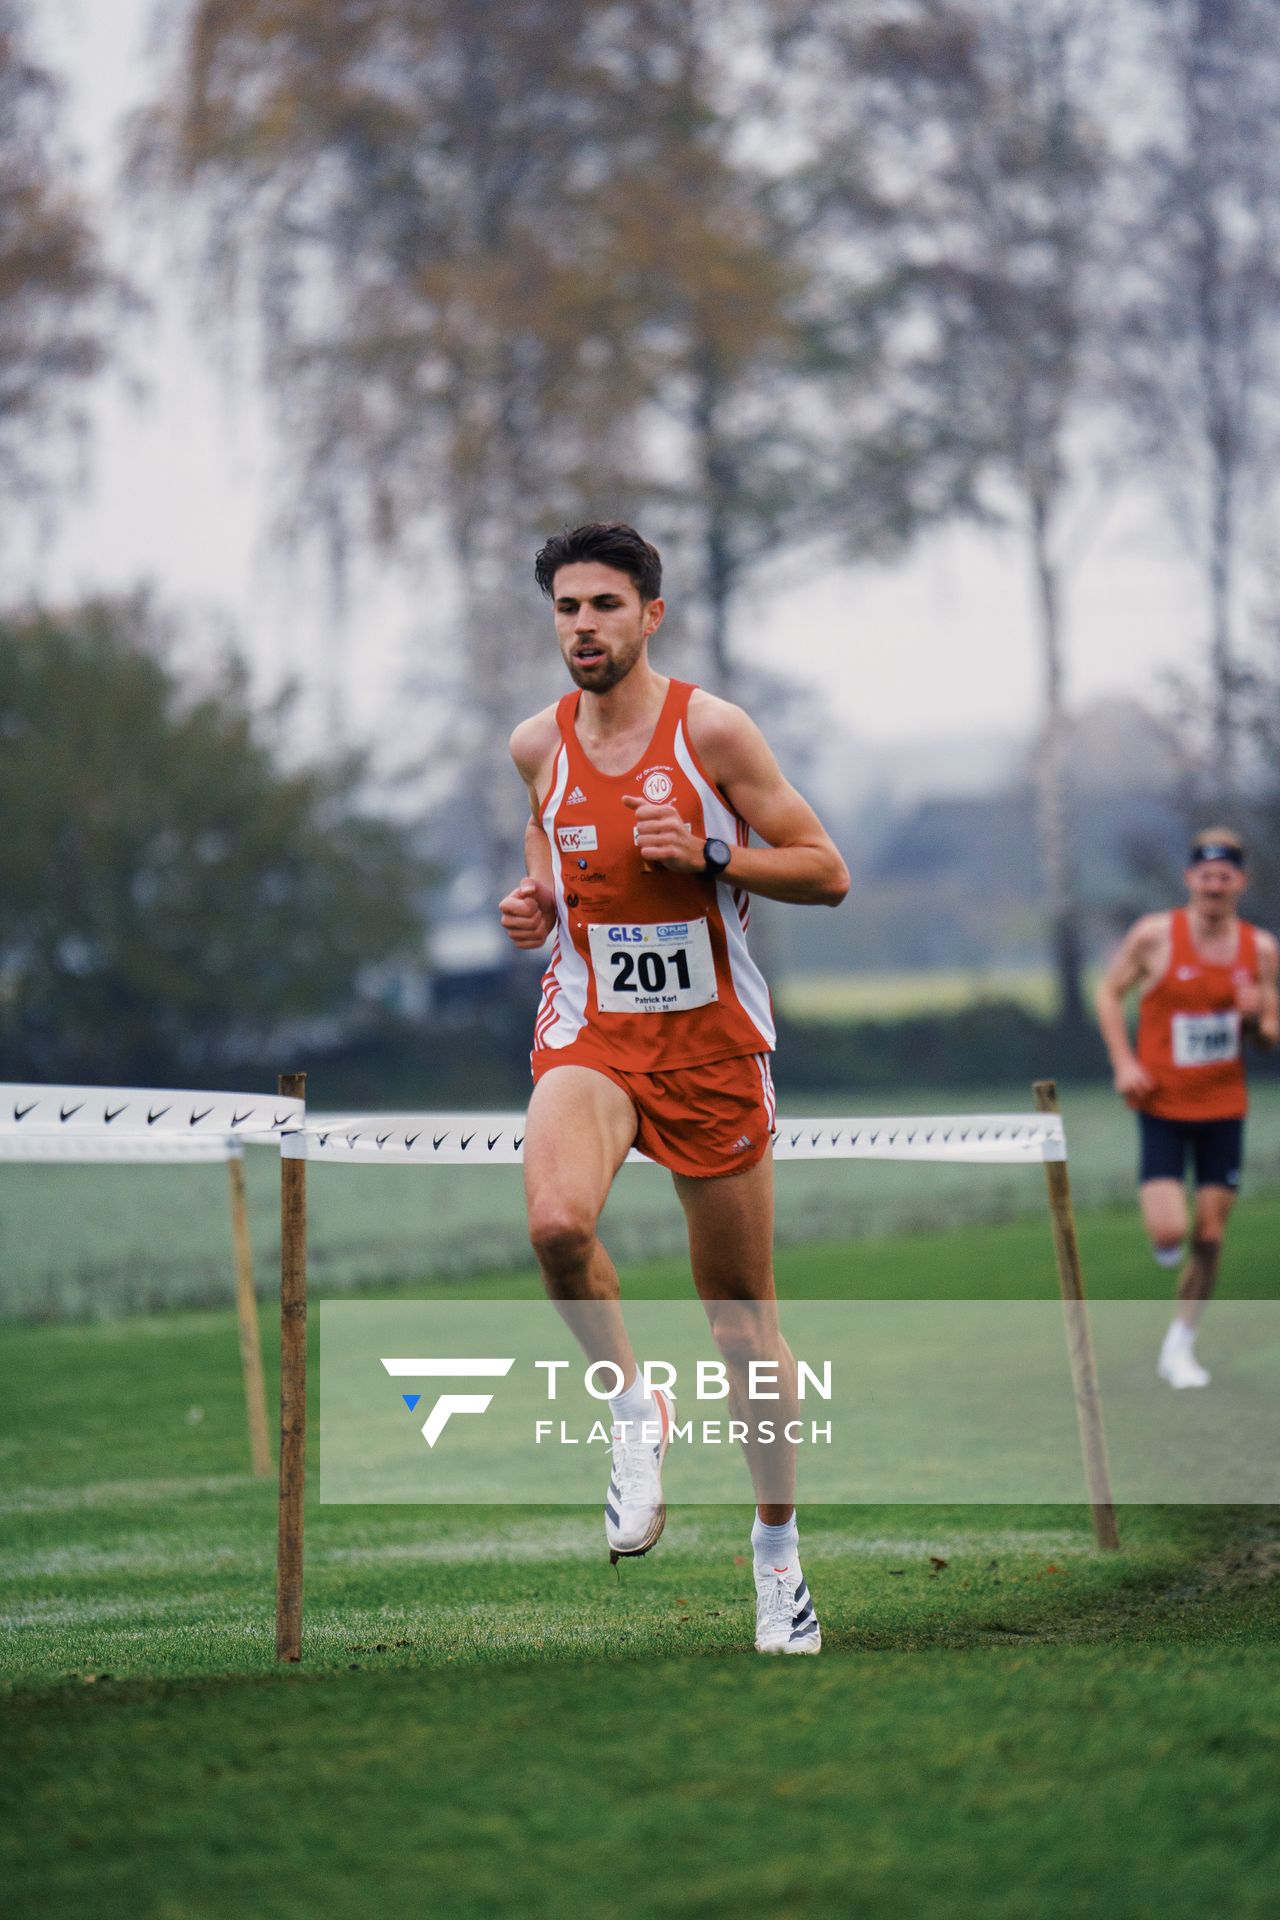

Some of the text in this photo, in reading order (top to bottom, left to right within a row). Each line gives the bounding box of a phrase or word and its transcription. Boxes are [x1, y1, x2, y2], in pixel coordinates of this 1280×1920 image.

[610, 949, 691, 993] 201
[635, 994, 677, 1004] Patrick Karl
